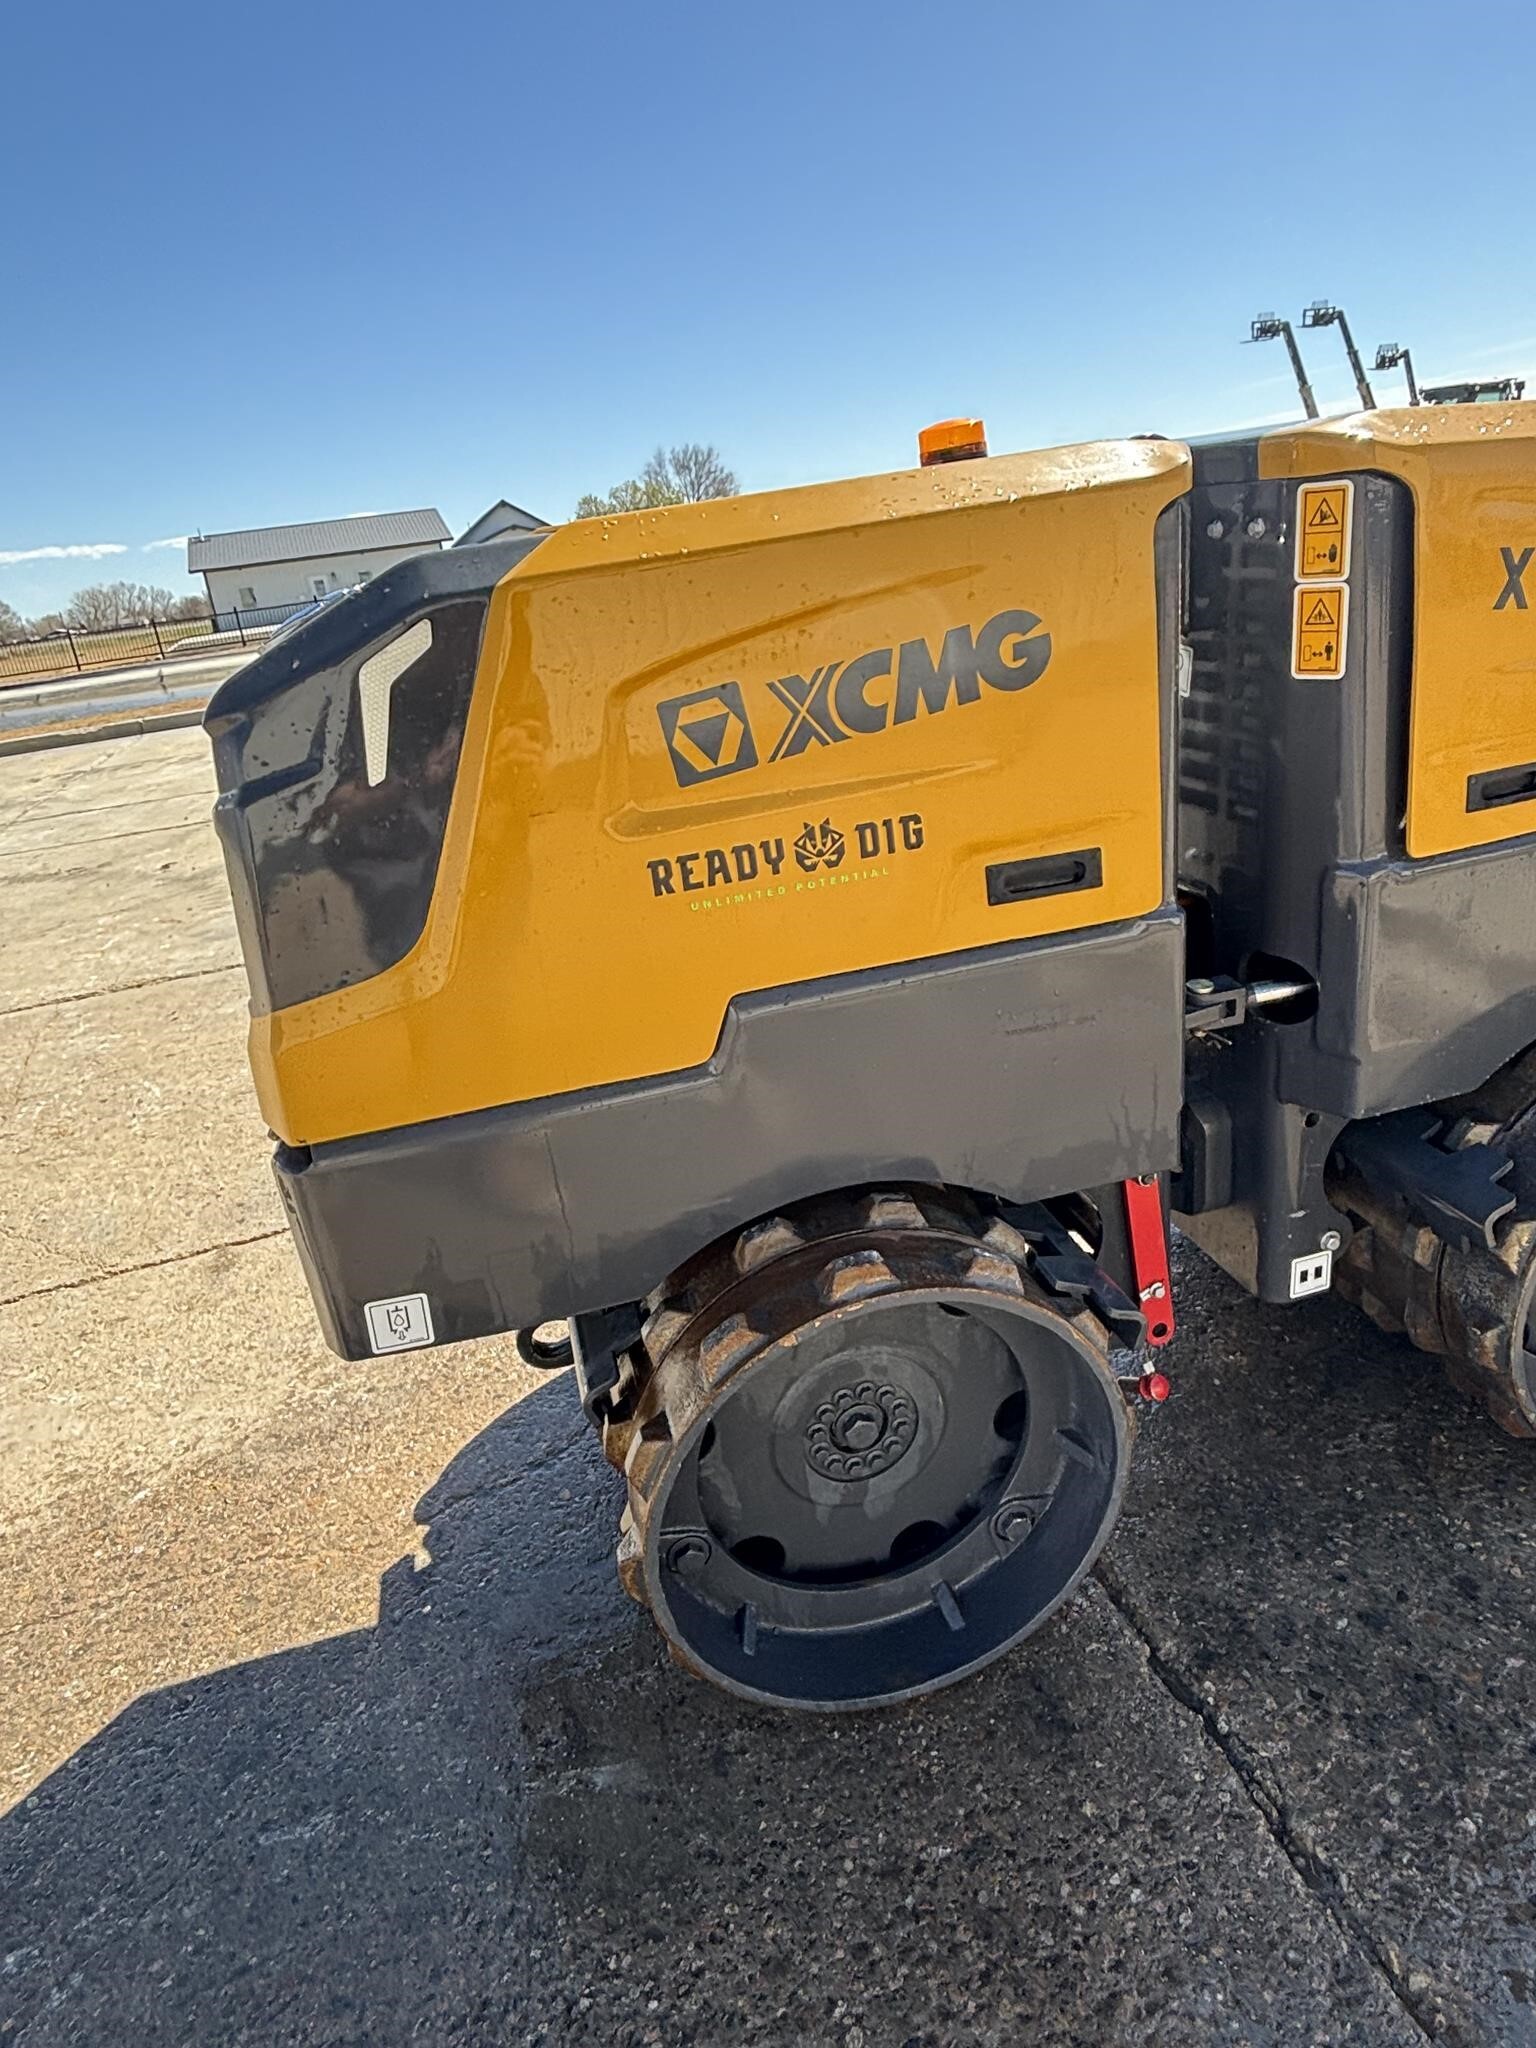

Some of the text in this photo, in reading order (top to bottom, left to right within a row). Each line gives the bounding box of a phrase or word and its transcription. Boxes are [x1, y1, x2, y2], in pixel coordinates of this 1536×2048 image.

[766, 609, 1052, 763] XCMG
[646, 813, 925, 897] READY DIG
[690, 867, 889, 911] UNLIMITED POTENTIAL
